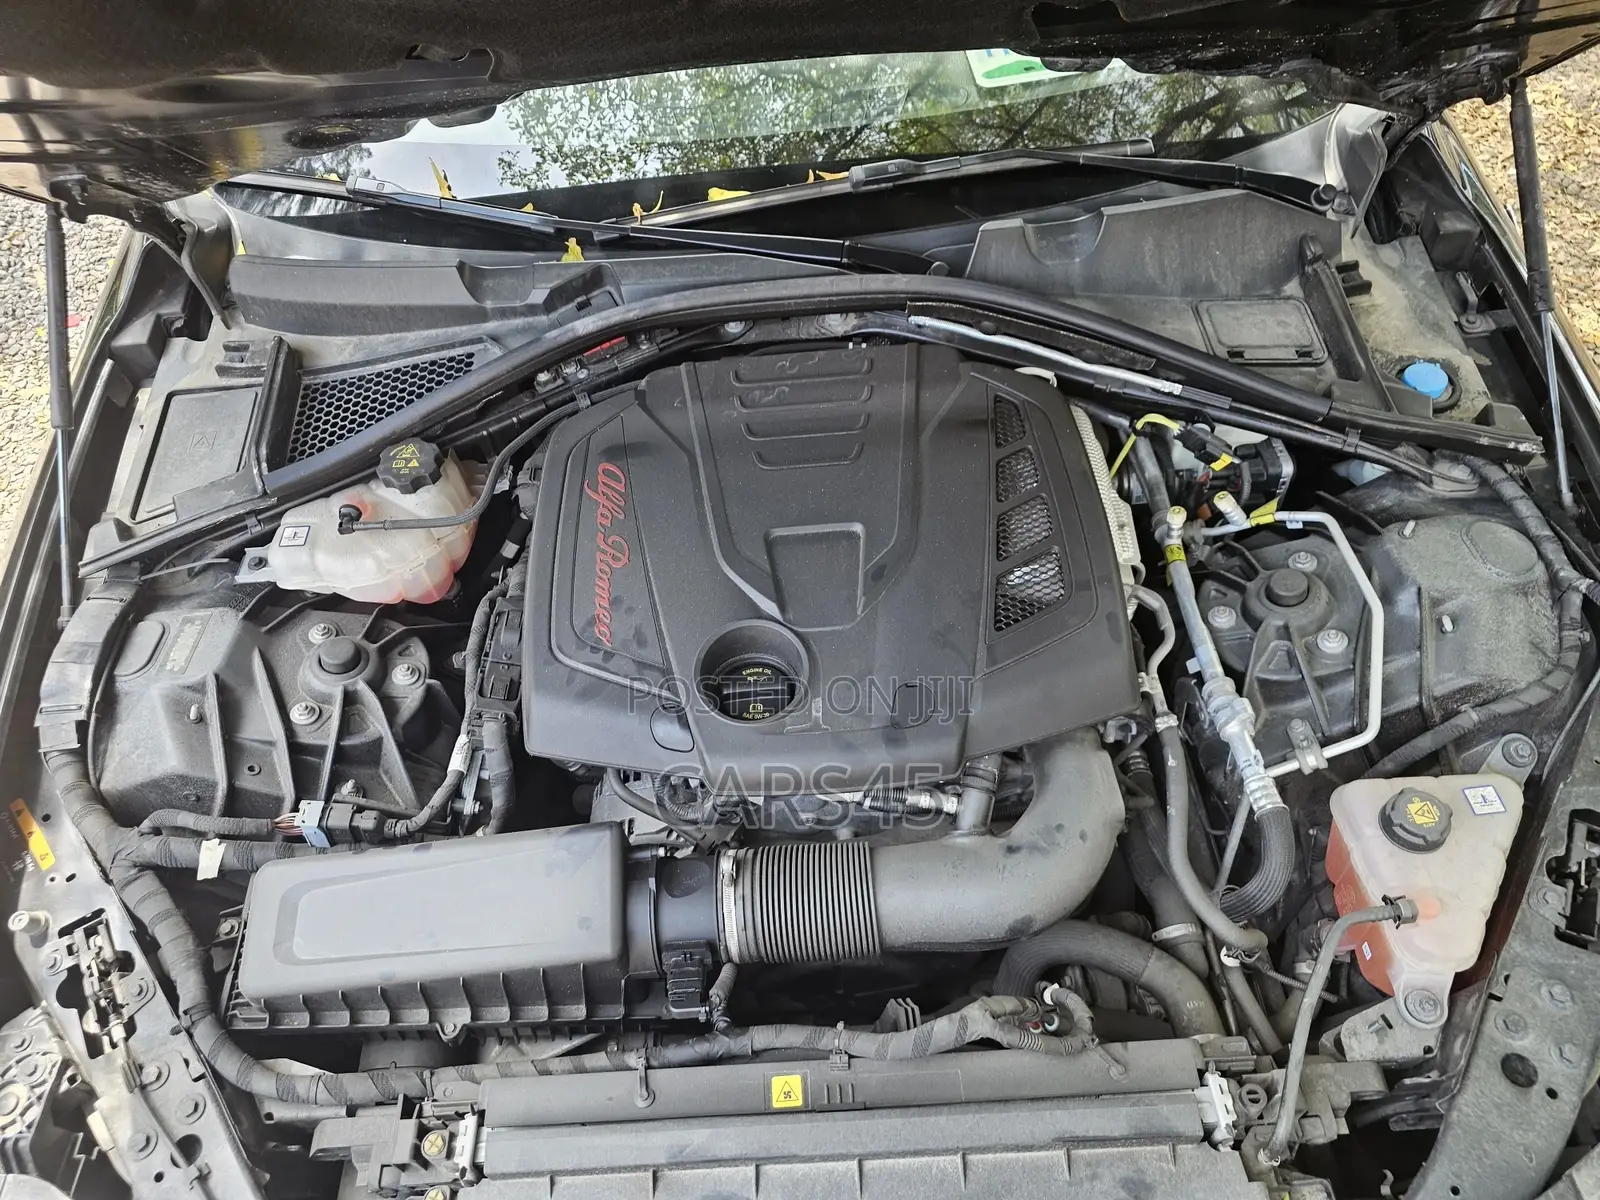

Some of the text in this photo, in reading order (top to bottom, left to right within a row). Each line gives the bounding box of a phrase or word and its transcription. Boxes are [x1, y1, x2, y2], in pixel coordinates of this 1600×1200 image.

[584, 462, 630, 648] Alfa Romeo
[742, 667, 763, 675] ENGINE
